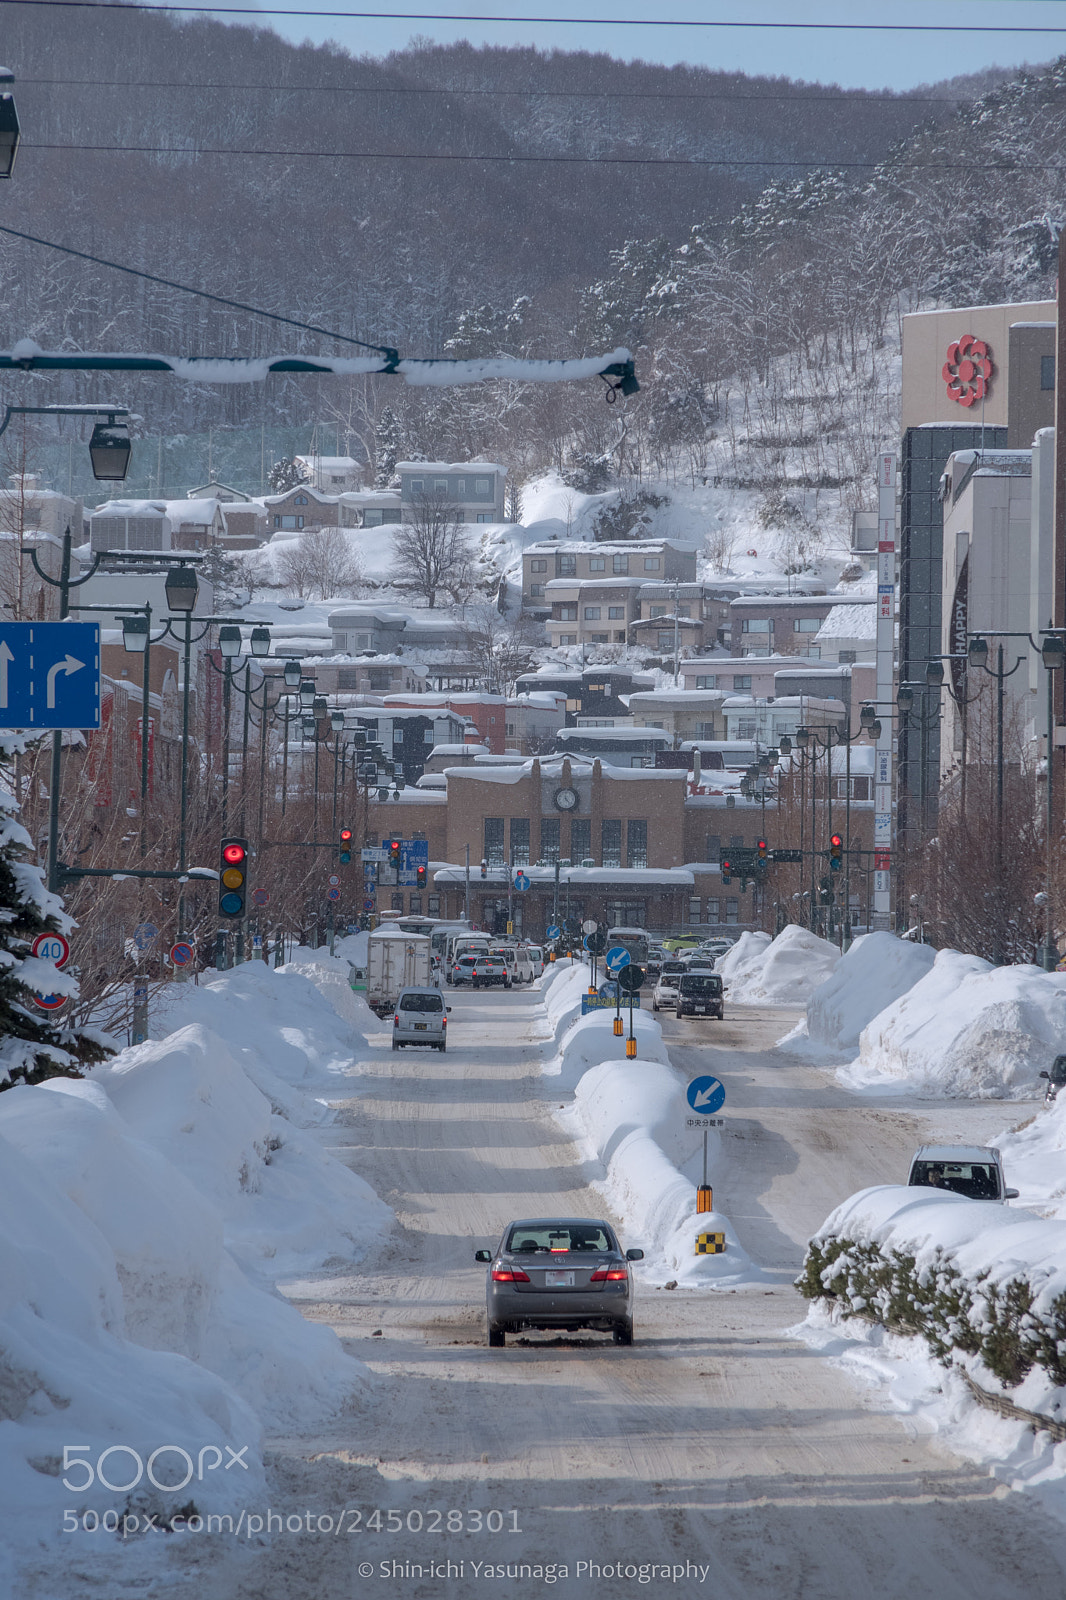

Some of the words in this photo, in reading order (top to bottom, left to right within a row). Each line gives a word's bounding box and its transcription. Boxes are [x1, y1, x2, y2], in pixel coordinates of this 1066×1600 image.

[955, 600, 966, 654] HAPPY
[41, 942, 61, 959] 40
[687, 1119, 724, 1127] 中央分離帯
